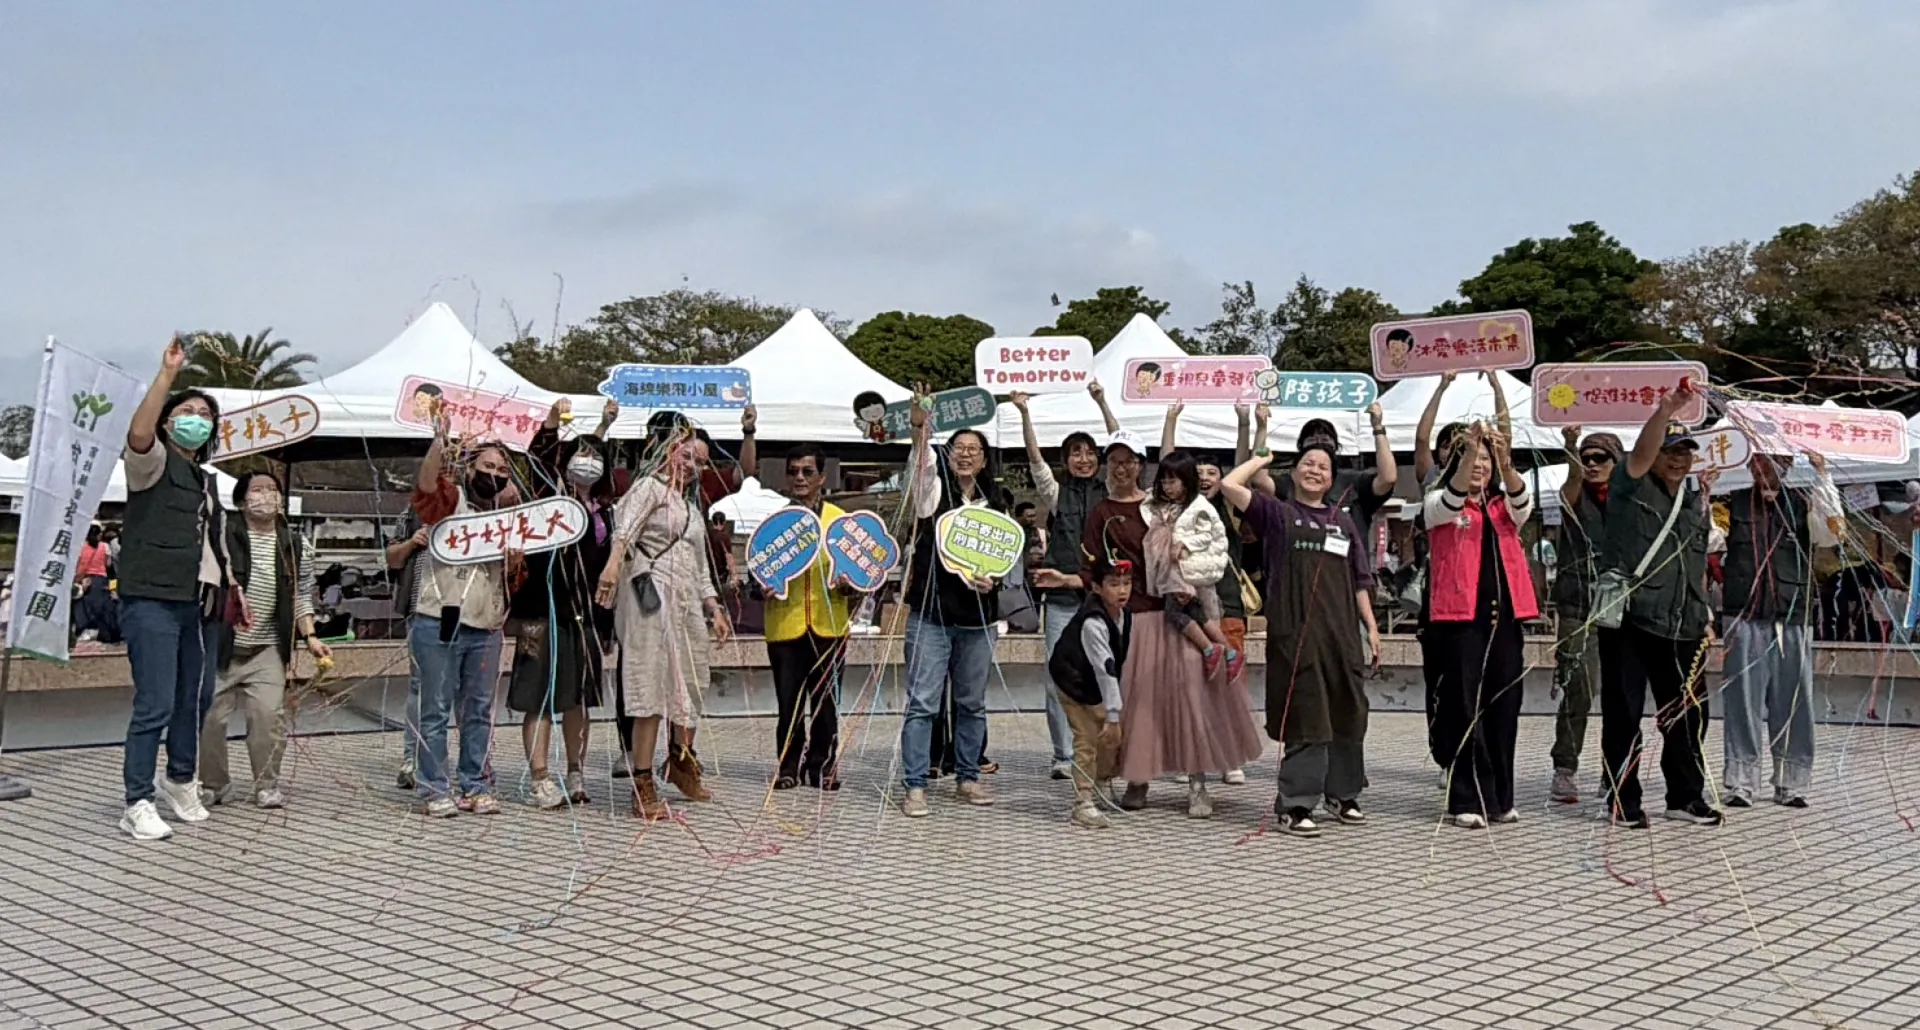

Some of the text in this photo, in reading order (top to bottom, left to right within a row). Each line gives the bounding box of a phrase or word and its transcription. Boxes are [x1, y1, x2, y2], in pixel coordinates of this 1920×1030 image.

[1000, 347, 1071, 363] Better
[983, 369, 1087, 383] Tomorrow
[1285, 378, 1369, 404] 陪孩子
[445, 509, 576, 556] 好好長大
